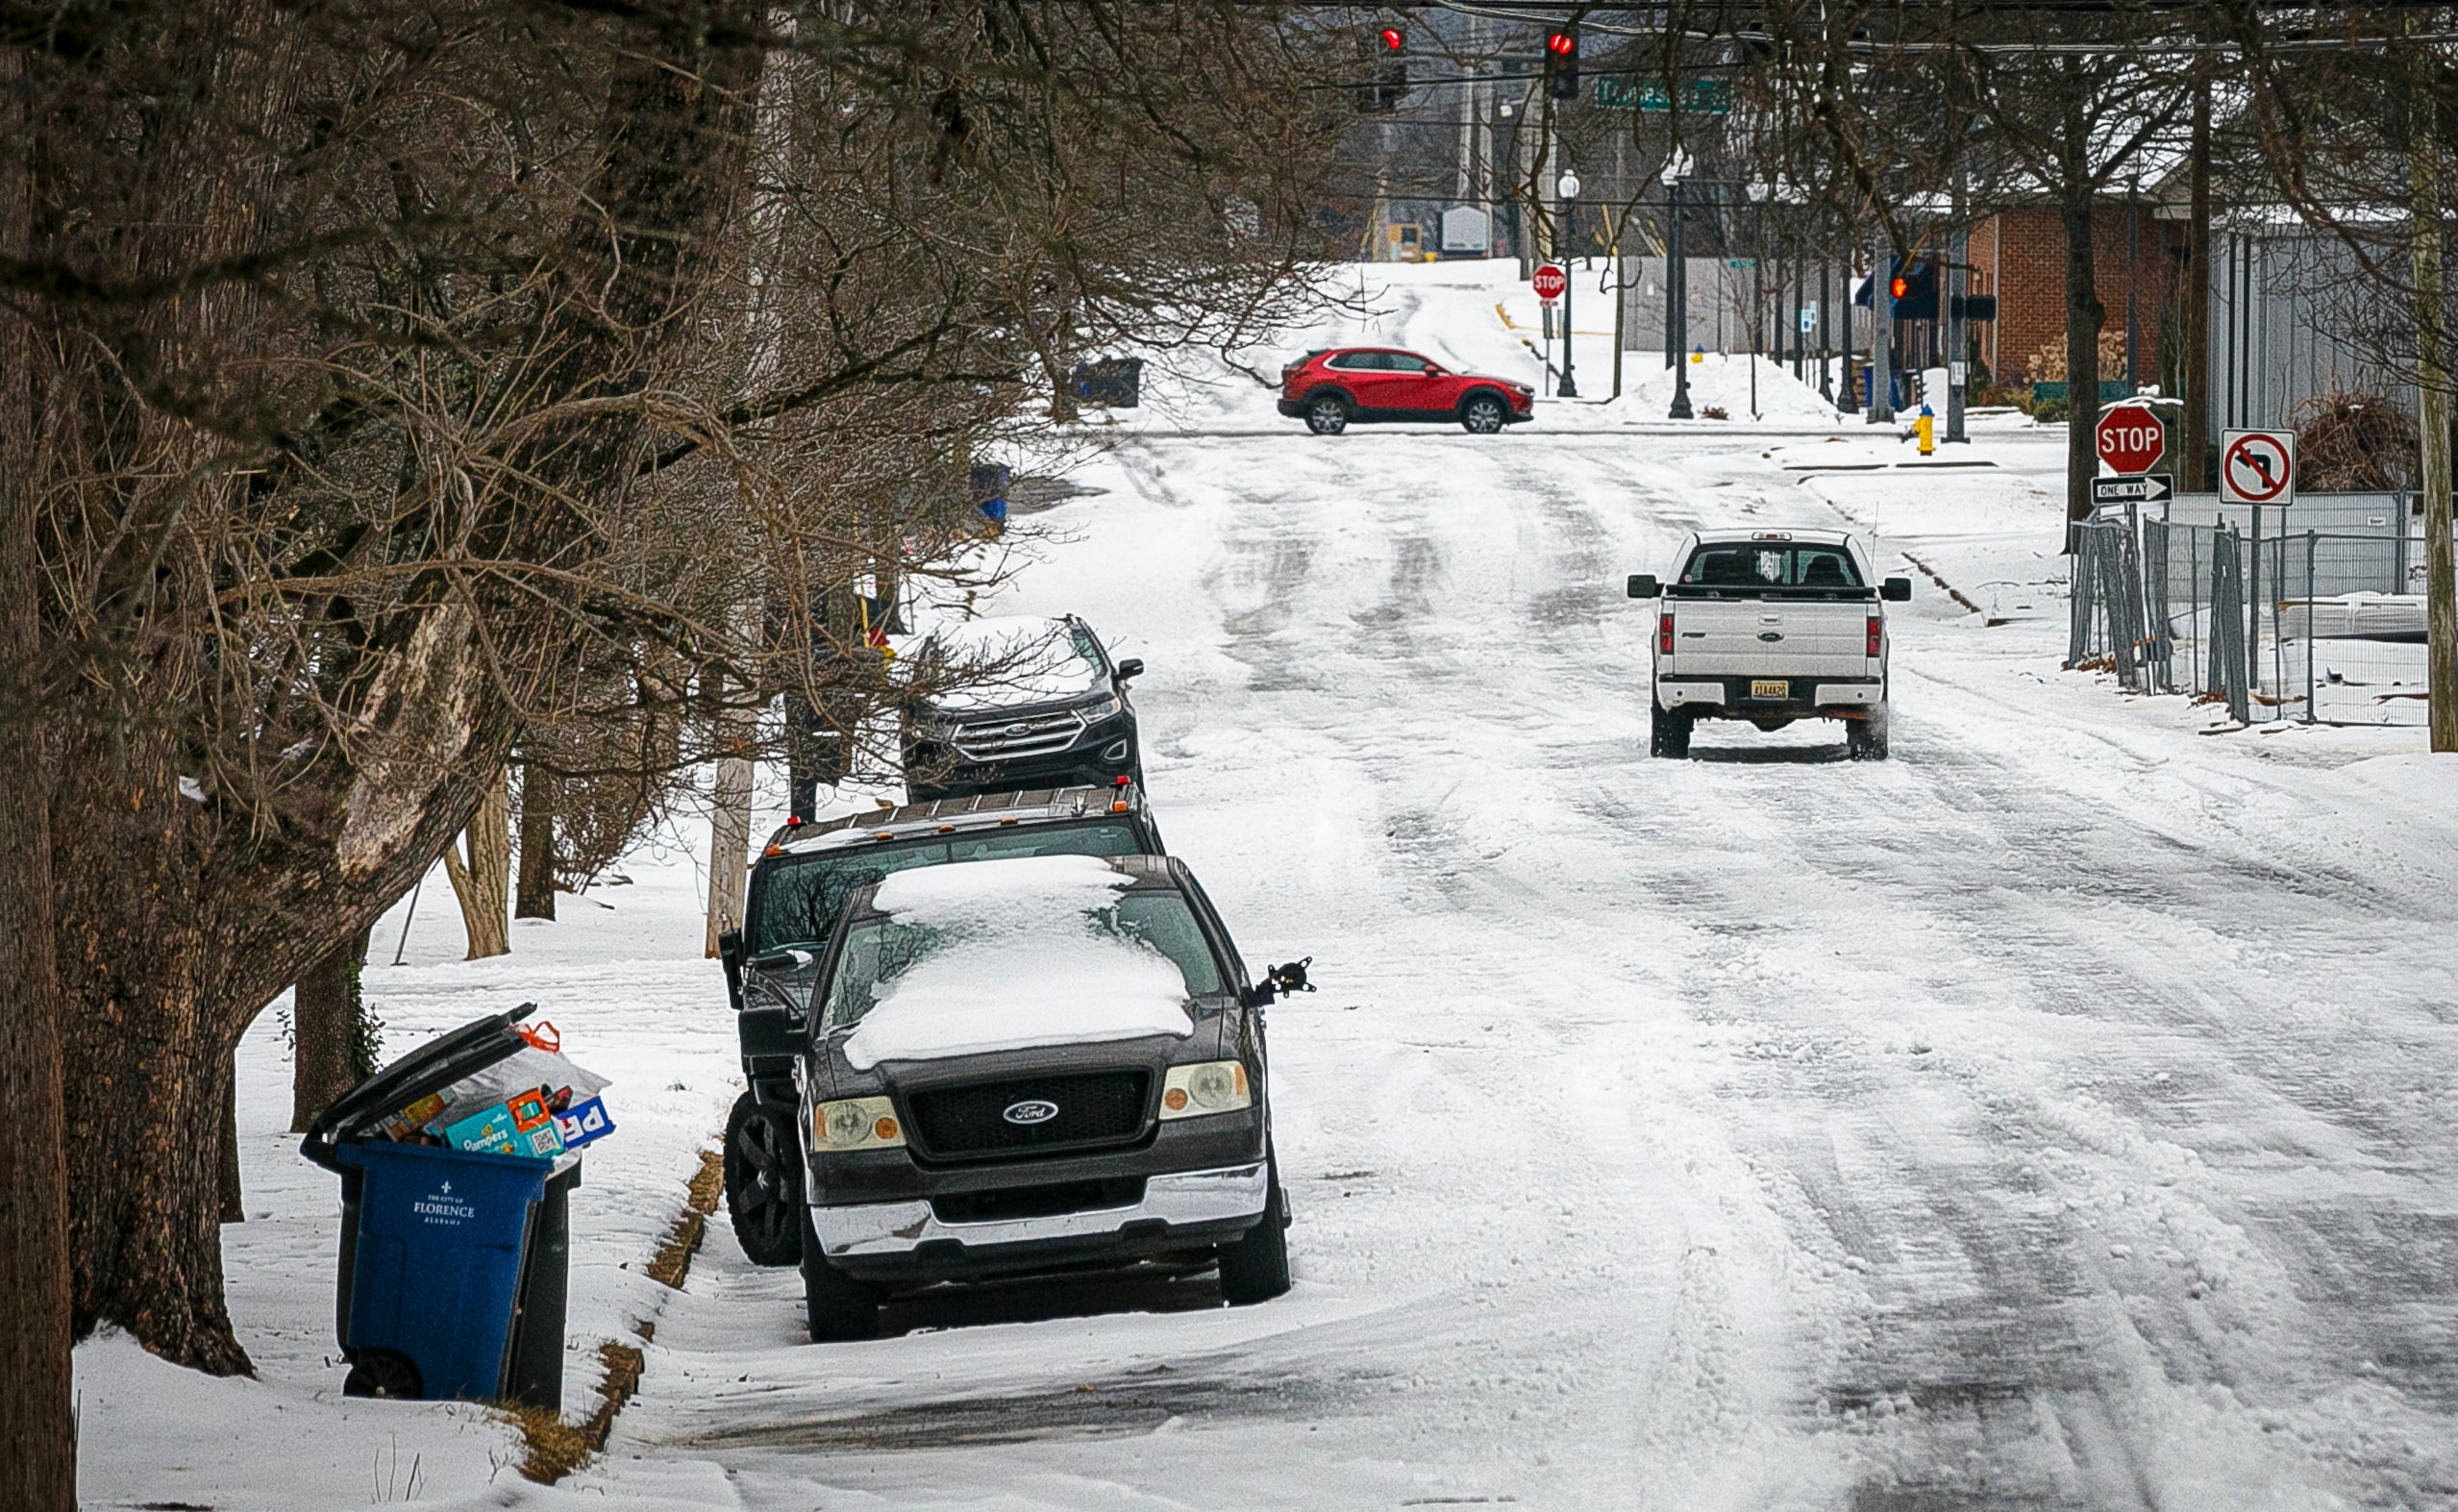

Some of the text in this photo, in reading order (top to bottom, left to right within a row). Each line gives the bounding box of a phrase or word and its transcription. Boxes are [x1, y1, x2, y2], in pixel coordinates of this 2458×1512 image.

[1535, 275, 1565, 290] STOP
[2101, 427, 2159, 453] STOP
[2100, 483, 2148, 496] ONE WAY
[1015, 1104, 1045, 1119] Ford
[463, 1129, 509, 1152] Pampers
[413, 1202, 476, 1219] FLORENCE
[424, 1216, 460, 1227] ALABAMA
